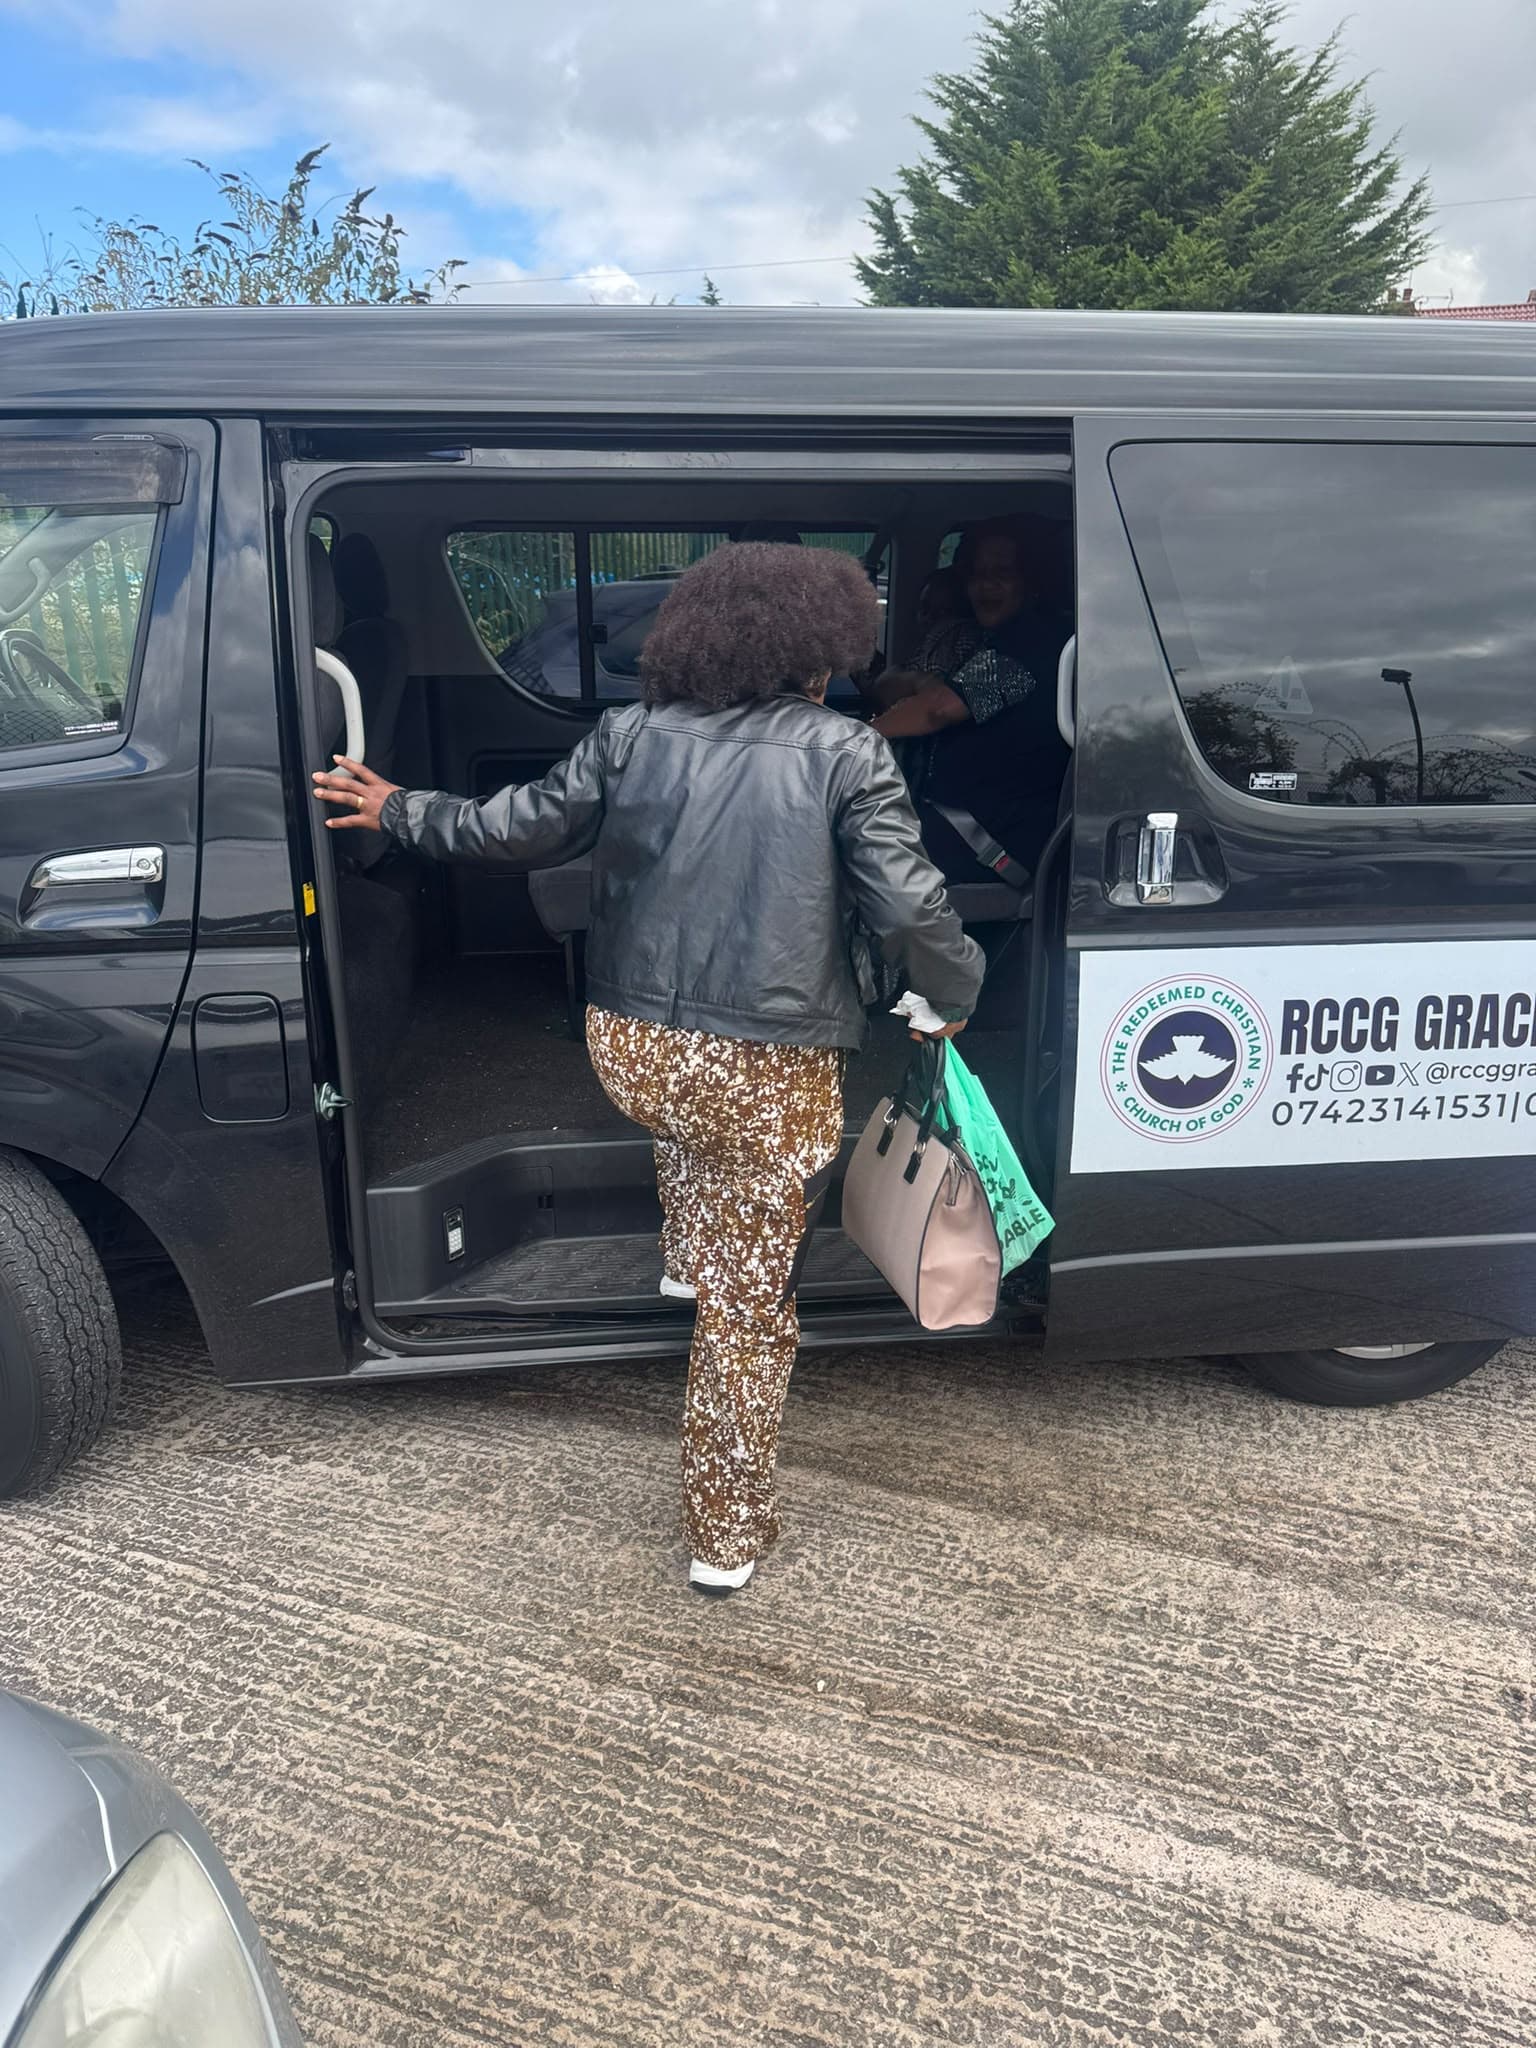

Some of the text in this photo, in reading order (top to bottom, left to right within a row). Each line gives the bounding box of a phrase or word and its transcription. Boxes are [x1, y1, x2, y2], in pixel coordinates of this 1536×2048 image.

[1112, 986, 1262, 1074] THE REDEEMED CHRISTIAN
[1280, 992, 1536, 1055] RCCG GRAC
[1123, 1093, 1244, 1132] CHURCH OF GOD
[999, 1207, 1046, 1251] ABLE
